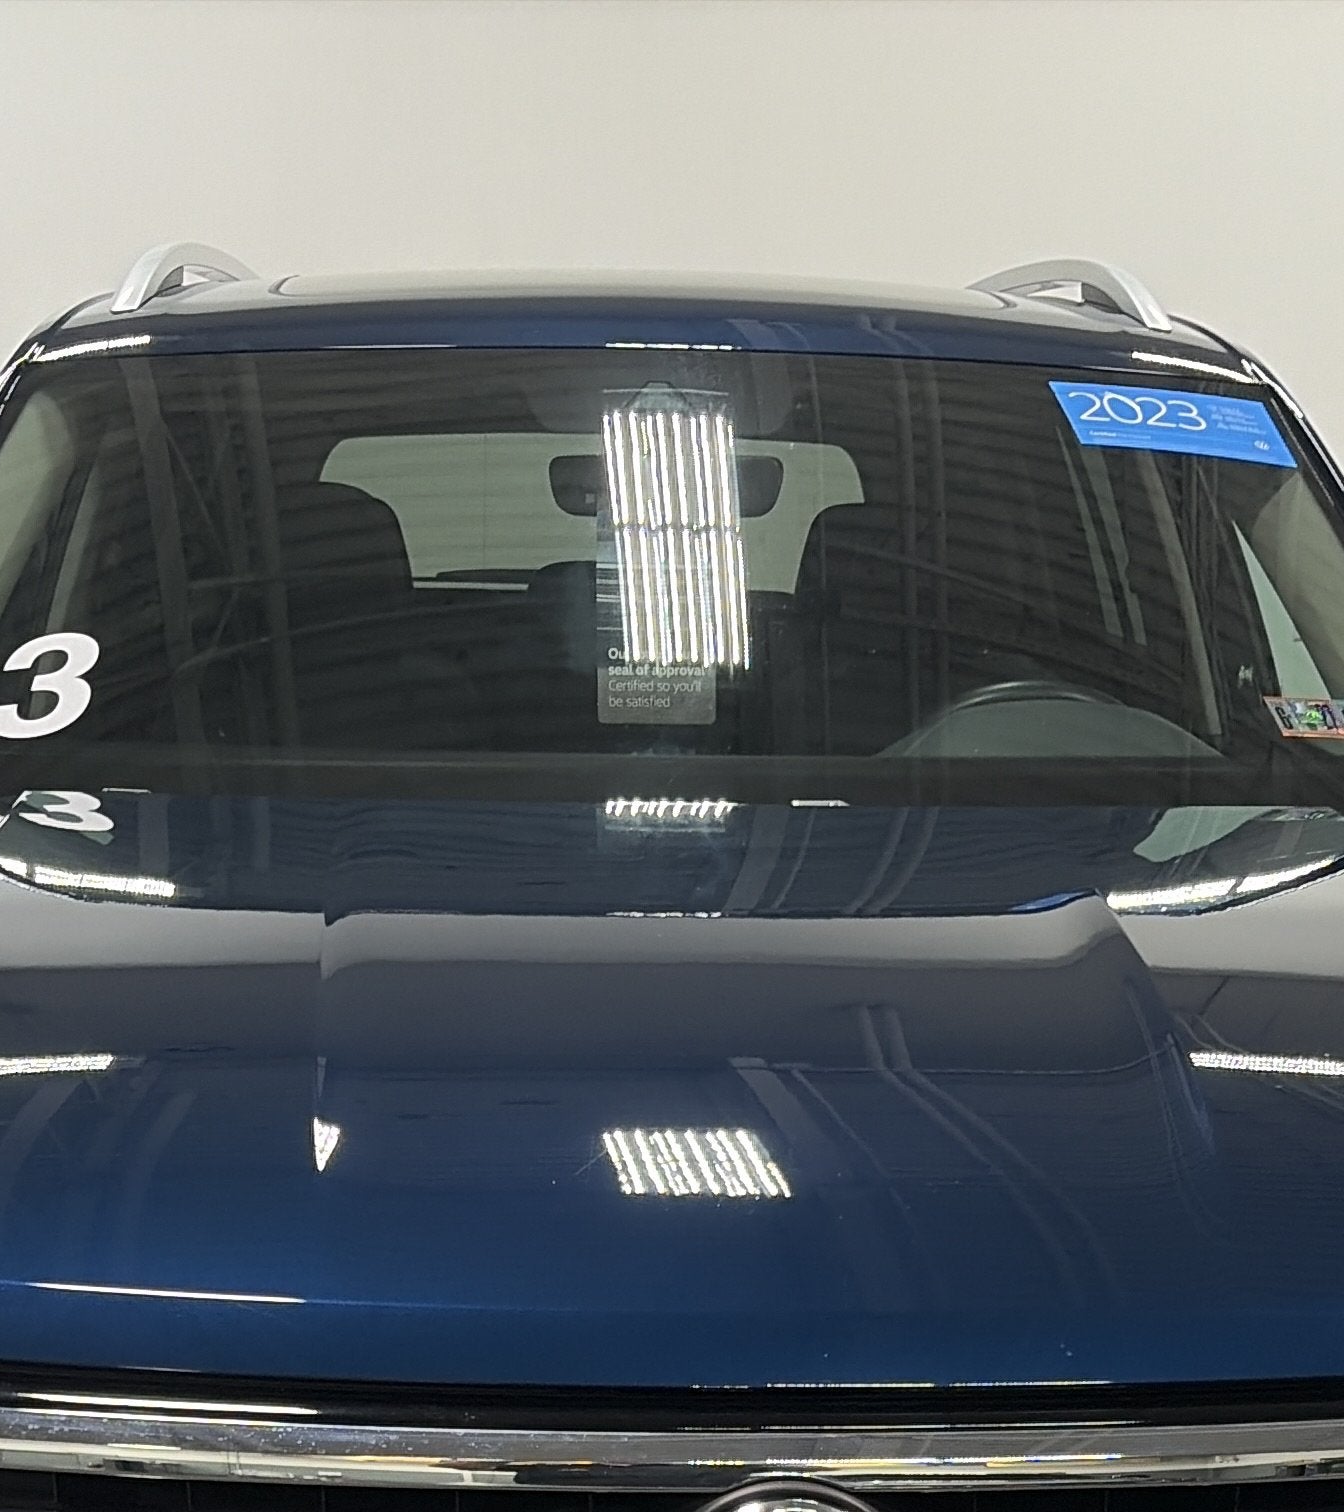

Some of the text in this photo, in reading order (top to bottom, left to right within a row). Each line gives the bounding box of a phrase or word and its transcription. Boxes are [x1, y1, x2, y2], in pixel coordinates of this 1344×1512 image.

[1067, 390, 1208, 432] 2023
[608, 665, 705, 679] seal of approval
[608, 679, 655, 692] Certified
[657, 682, 670, 692] so
[609, 696, 671, 708] be satisfied
